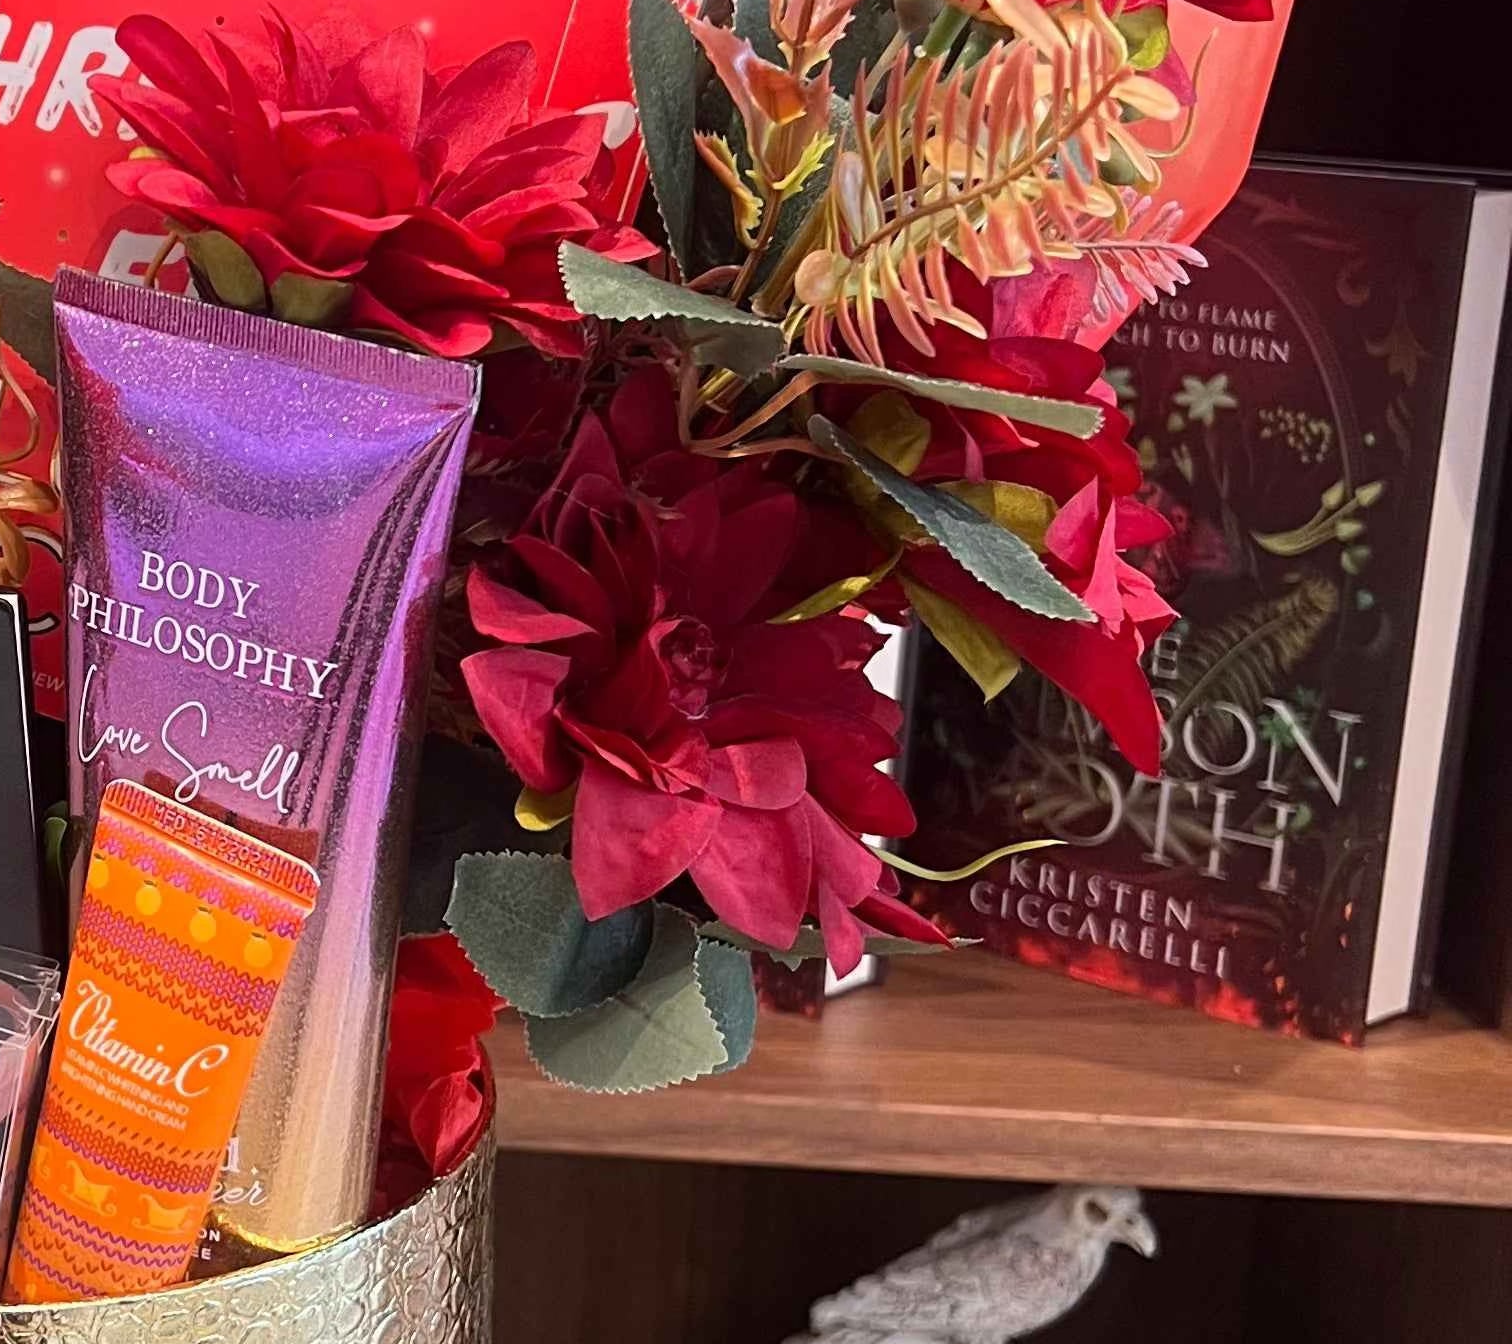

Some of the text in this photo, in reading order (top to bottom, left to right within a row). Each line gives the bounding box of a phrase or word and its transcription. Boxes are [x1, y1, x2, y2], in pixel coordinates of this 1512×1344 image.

[1161, 325, 1290, 364] TO BURN
[1197, 303, 1278, 332] FLAME
[138, 549, 261, 620] BODY
[68, 582, 340, 700] PHILOSOPHY
[77, 663, 300, 814] Love Smell
[968, 880, 1230, 979] CICCARELLI
[1009, 854, 1194, 931] KRISTEN
[68, 979, 230, 1098] Vitamin C
